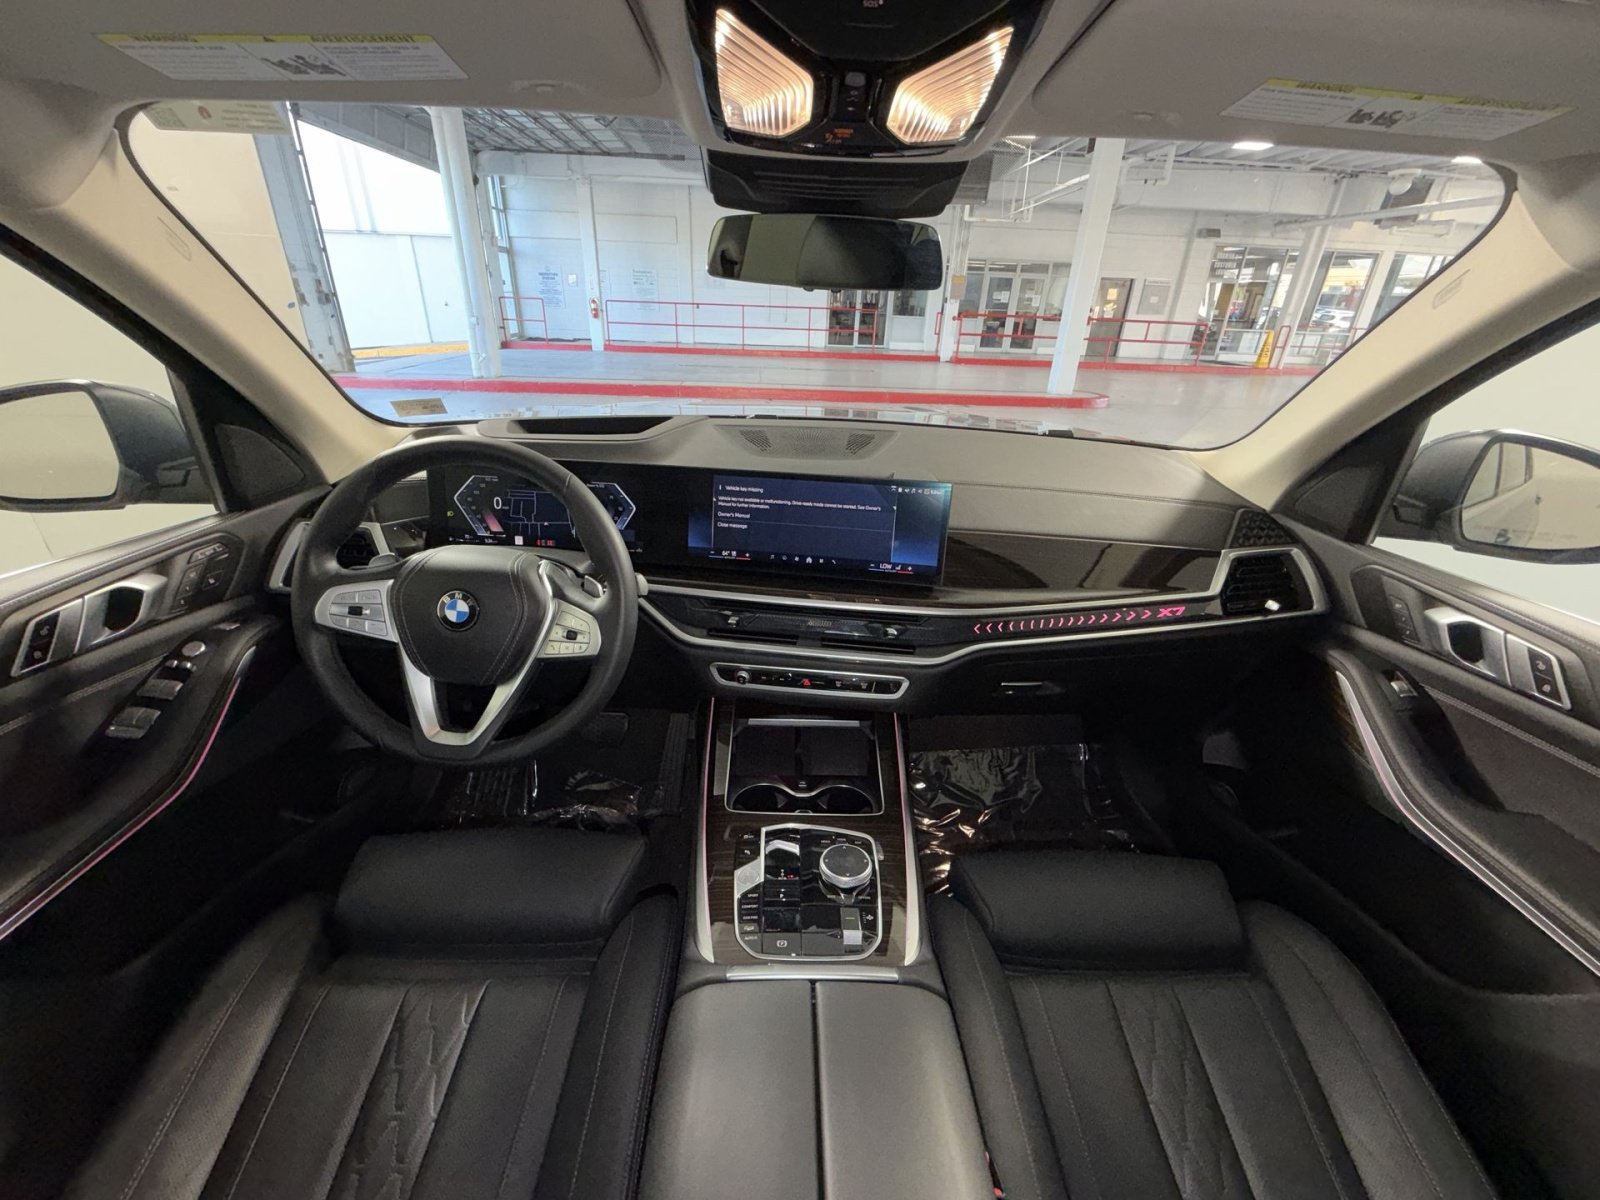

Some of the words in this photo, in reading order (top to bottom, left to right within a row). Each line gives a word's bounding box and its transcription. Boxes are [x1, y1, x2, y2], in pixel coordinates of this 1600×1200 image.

[494, 496, 502, 509] 0
[442, 592, 476, 606] BMW
[1158, 606, 1186, 617] X7
